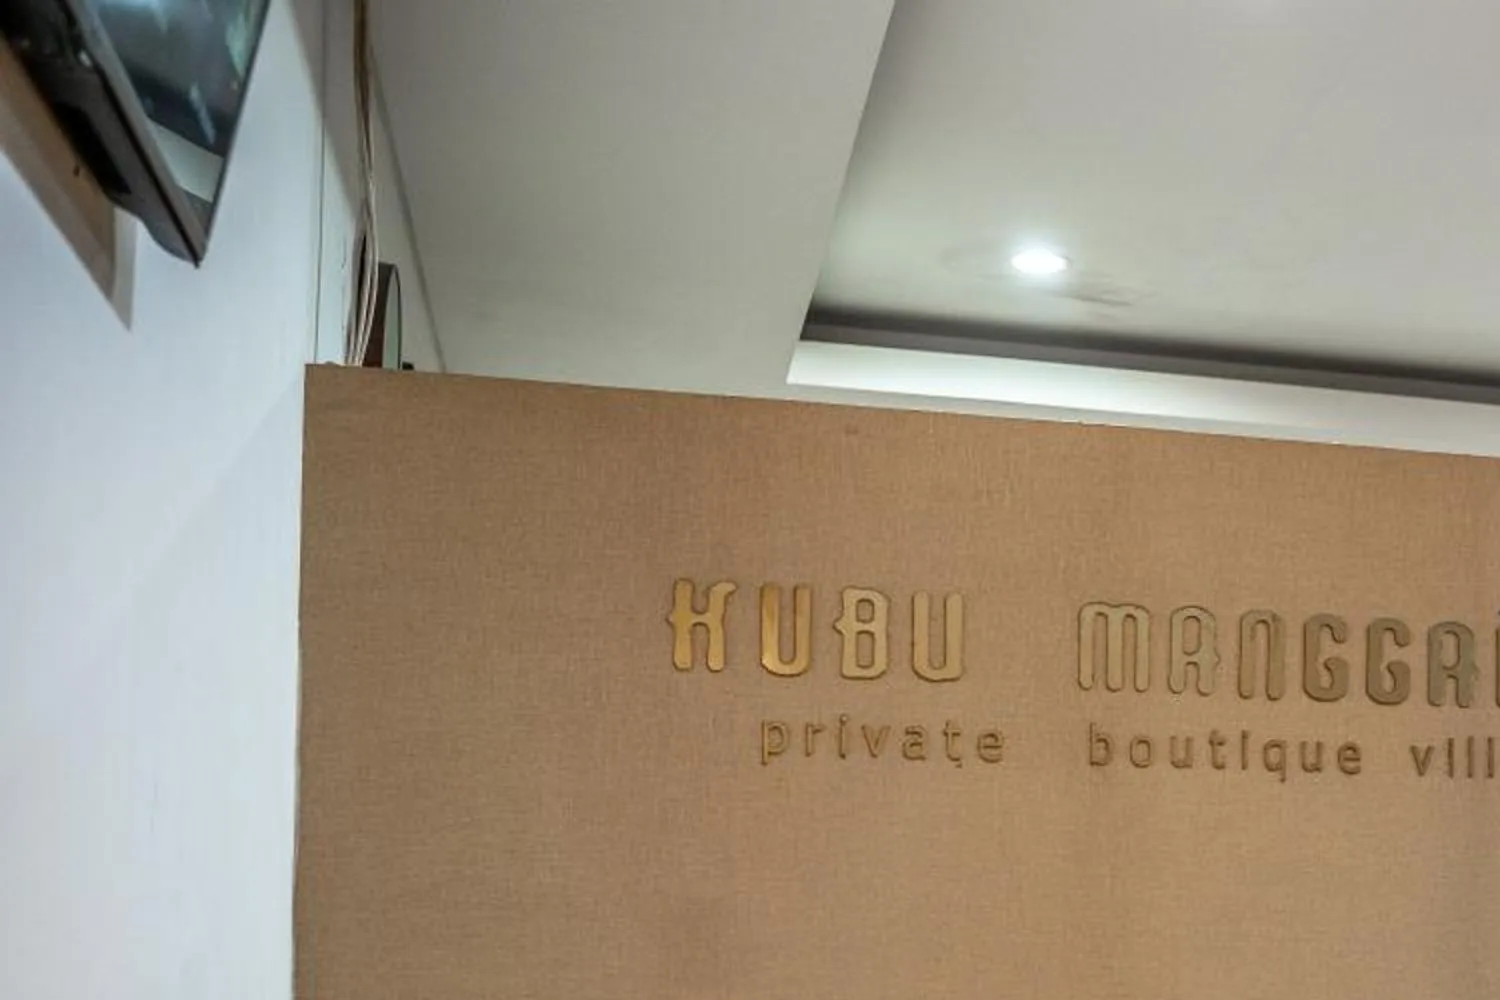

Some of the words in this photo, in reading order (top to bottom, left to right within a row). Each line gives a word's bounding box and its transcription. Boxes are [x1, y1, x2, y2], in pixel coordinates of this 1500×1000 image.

[665, 577, 966, 683] HUBU
[760, 712, 1005, 769] private
[1087, 721, 1363, 784] boutique
